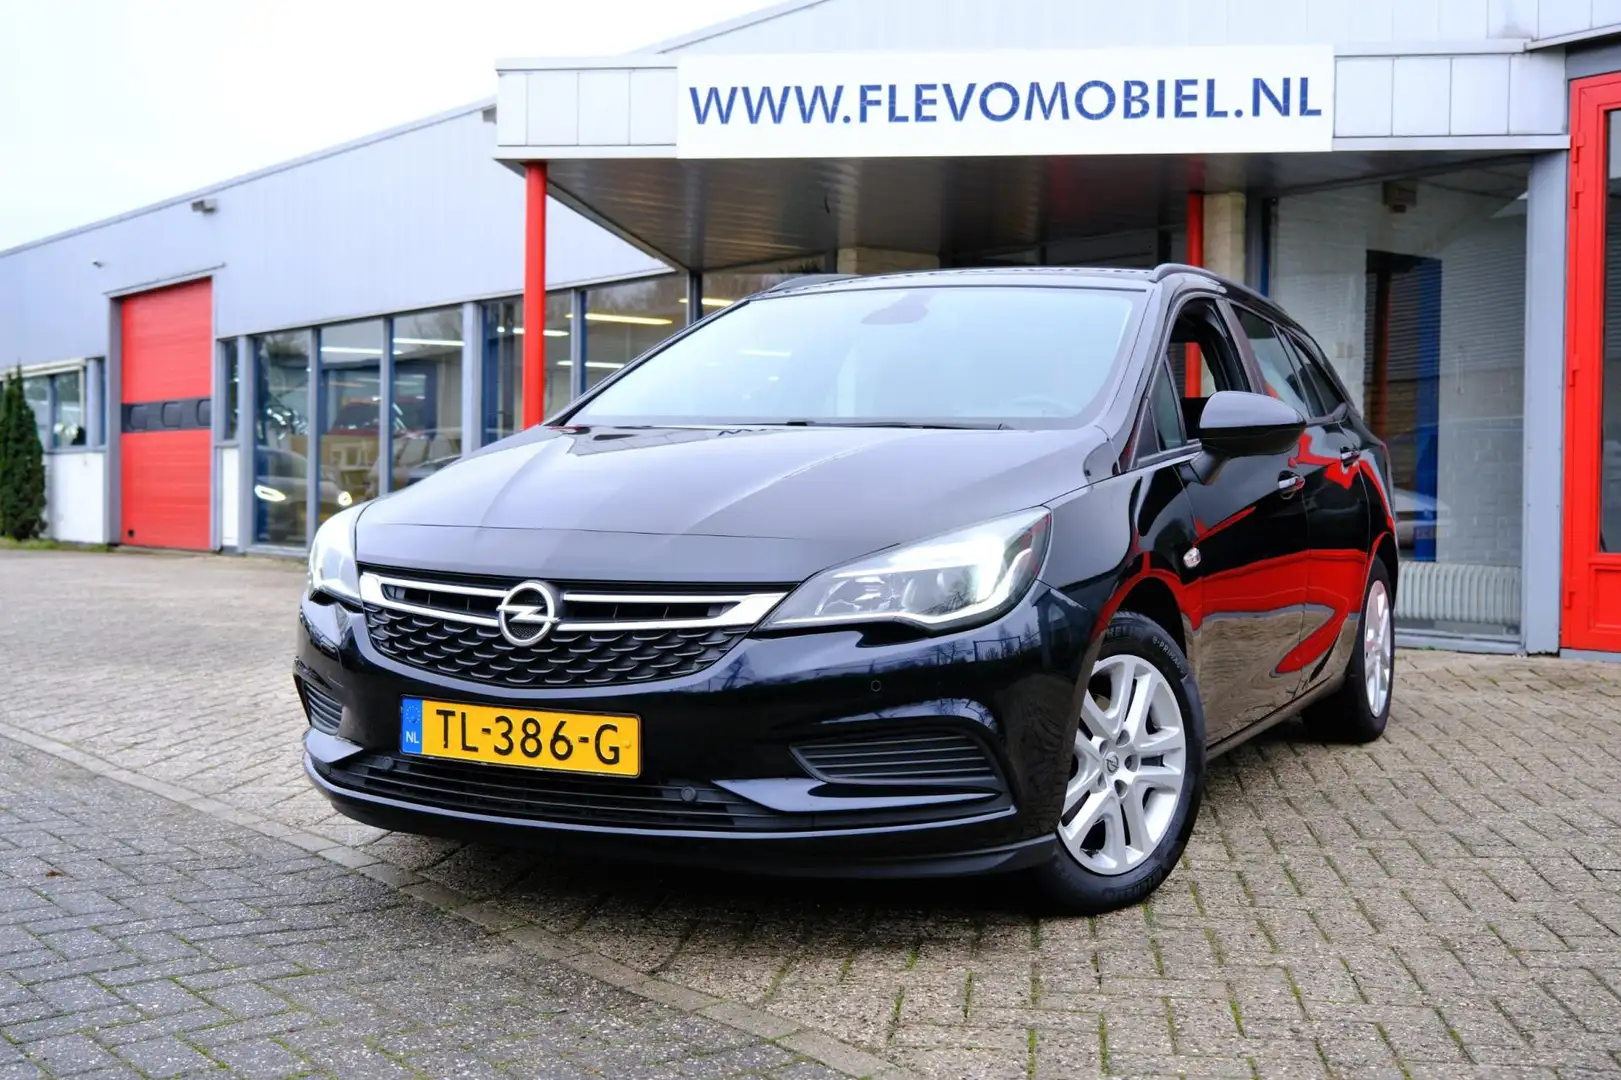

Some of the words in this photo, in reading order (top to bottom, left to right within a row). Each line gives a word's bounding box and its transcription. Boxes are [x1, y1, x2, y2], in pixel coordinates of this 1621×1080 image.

[689, 77, 1323, 125] WWW.FLEVOMOBIEL.NL
[405, 731, 420, 744] NL
[436, 709, 620, 765] TL-386-G
